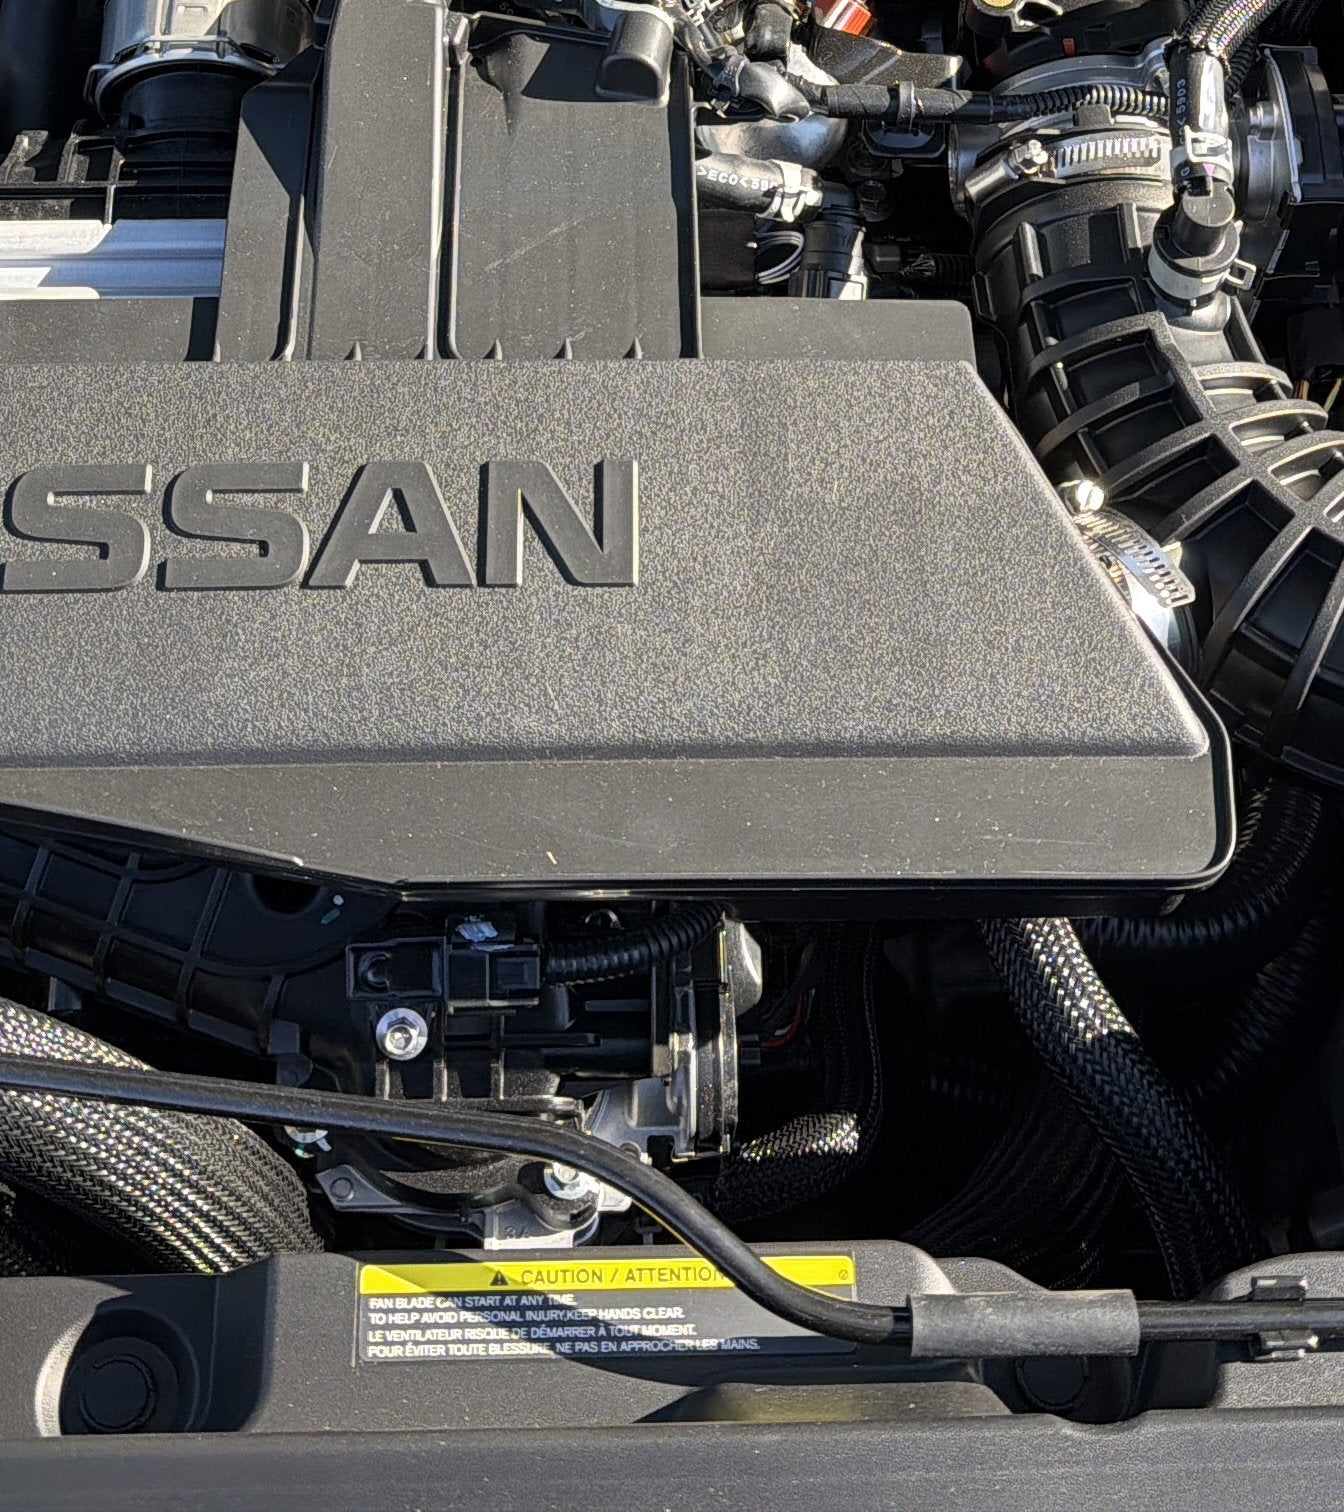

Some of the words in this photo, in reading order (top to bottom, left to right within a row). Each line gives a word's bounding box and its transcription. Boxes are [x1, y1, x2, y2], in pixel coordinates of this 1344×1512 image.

[521, 1268, 602, 1285] CAUTION
[609, 1268, 619, 1283] /
[369, 1297, 394, 1309] FAN
[395, 1296, 436, 1309] BLADE
[436, 1296, 462, 1308] CAN
[464, 1296, 501, 1307] START
[503, 1295, 517, 1306] AT
[520, 1295, 544, 1306] ANY
[548, 1293, 578, 1306] TIME.
[368, 1313, 386, 1325] TO
[388, 1312, 420, 1324] HELP
[421, 1312, 456, 1323] AVOID
[459, 1311, 524, 1323] PERSONAL
[598, 1308, 641, 1320] HANDS
[643, 1306, 685, 1319] CLEAR.
[368, 1330, 385, 1342] LE
[385, 1328, 462, 1341] VENTILATEUR
[464, 1327, 510, 1340] RISQUE
[511, 1327, 529, 1339] DE
[531, 1324, 597, 1338] DÉMARRER
[598, 1322, 605, 1336] À
[610, 1324, 641, 1336] TOUT
[641, 1323, 697, 1335] MOMENT.
[368, 1345, 404, 1358] POUR
[405, 1342, 446, 1357] ÉVITER
[448, 1343, 487, 1356] TOUTE
[556, 1341, 571, 1353] NE
[575, 1340, 598, 1353] PAS
[601, 1340, 617, 1352] EN
[619, 1339, 694, 1352] APPROCHER
[696, 1338, 718, 1351] LES
[720, 1338, 760, 1350] MAINS.
